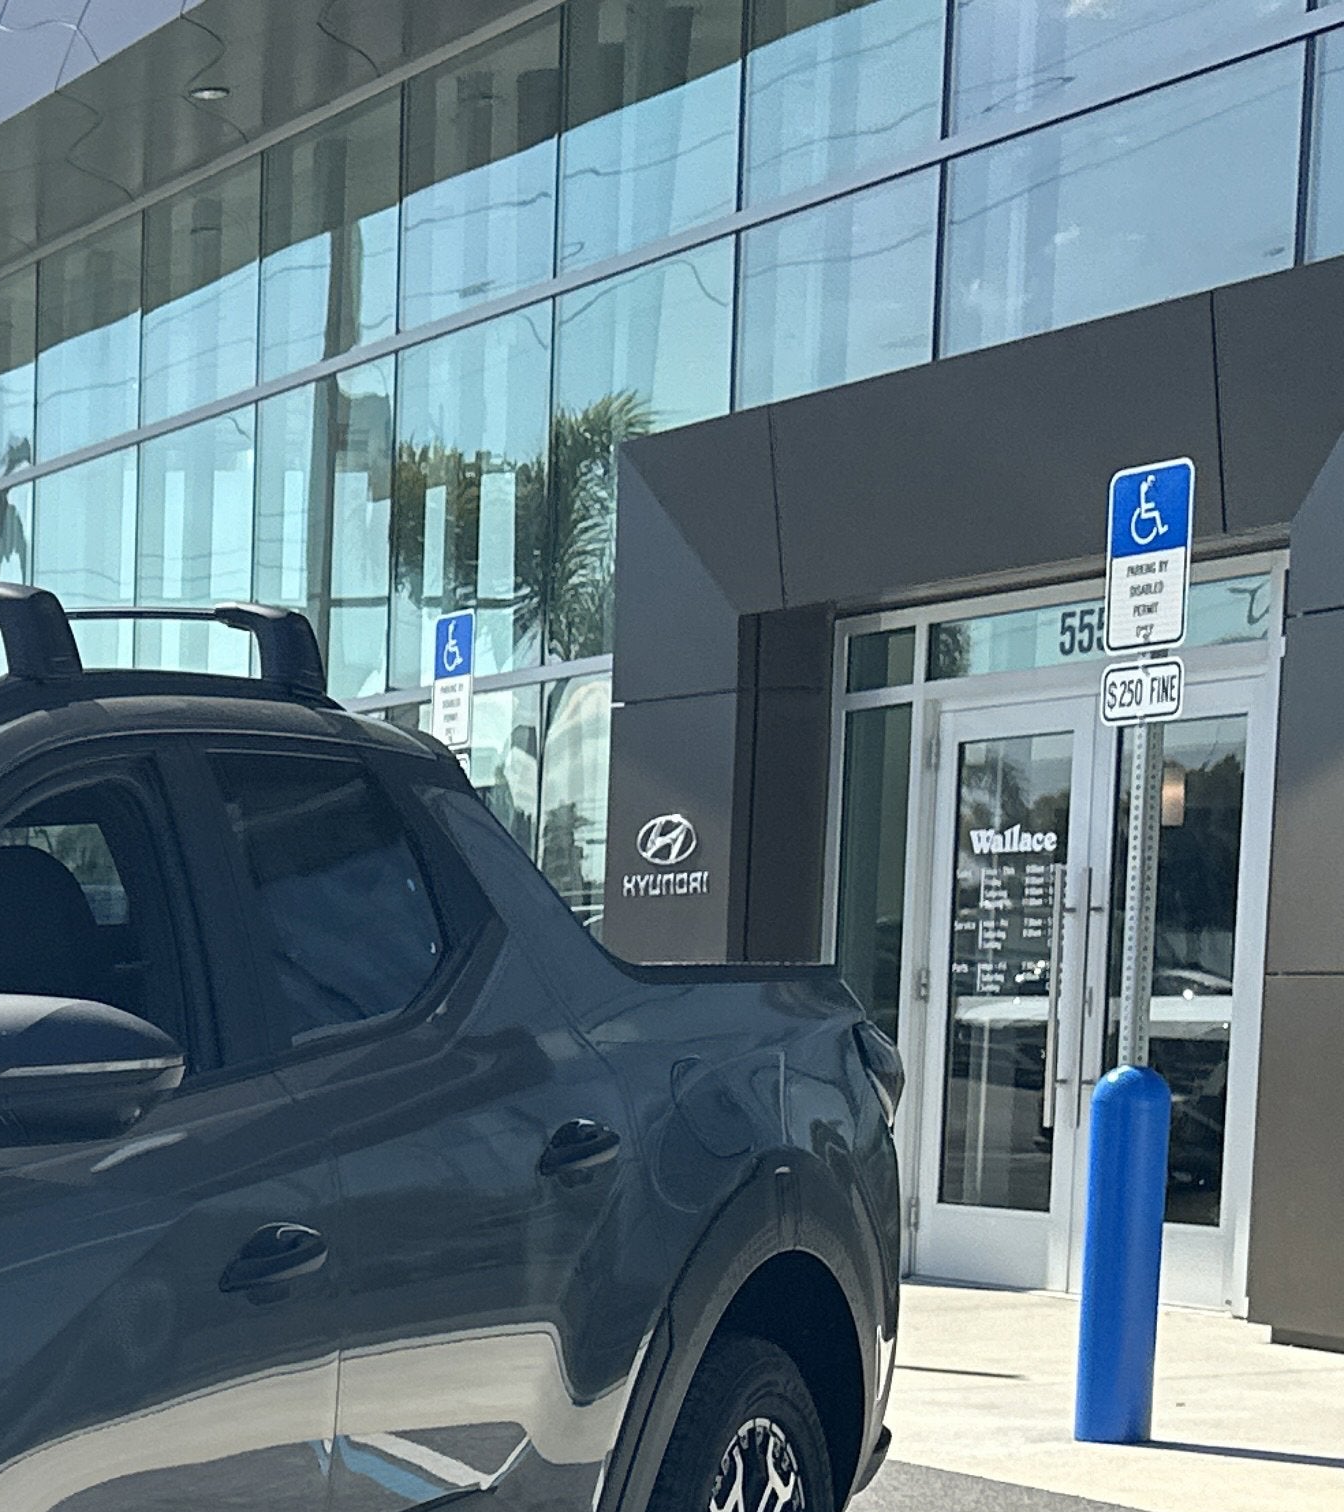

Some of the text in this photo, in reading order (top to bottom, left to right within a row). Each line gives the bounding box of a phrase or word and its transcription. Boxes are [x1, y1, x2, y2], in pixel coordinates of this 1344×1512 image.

[1107, 674, 1177, 711] $250 FINE
[969, 823, 1058, 855] Wallace
[622, 871, 709, 897] HYUNDAI
